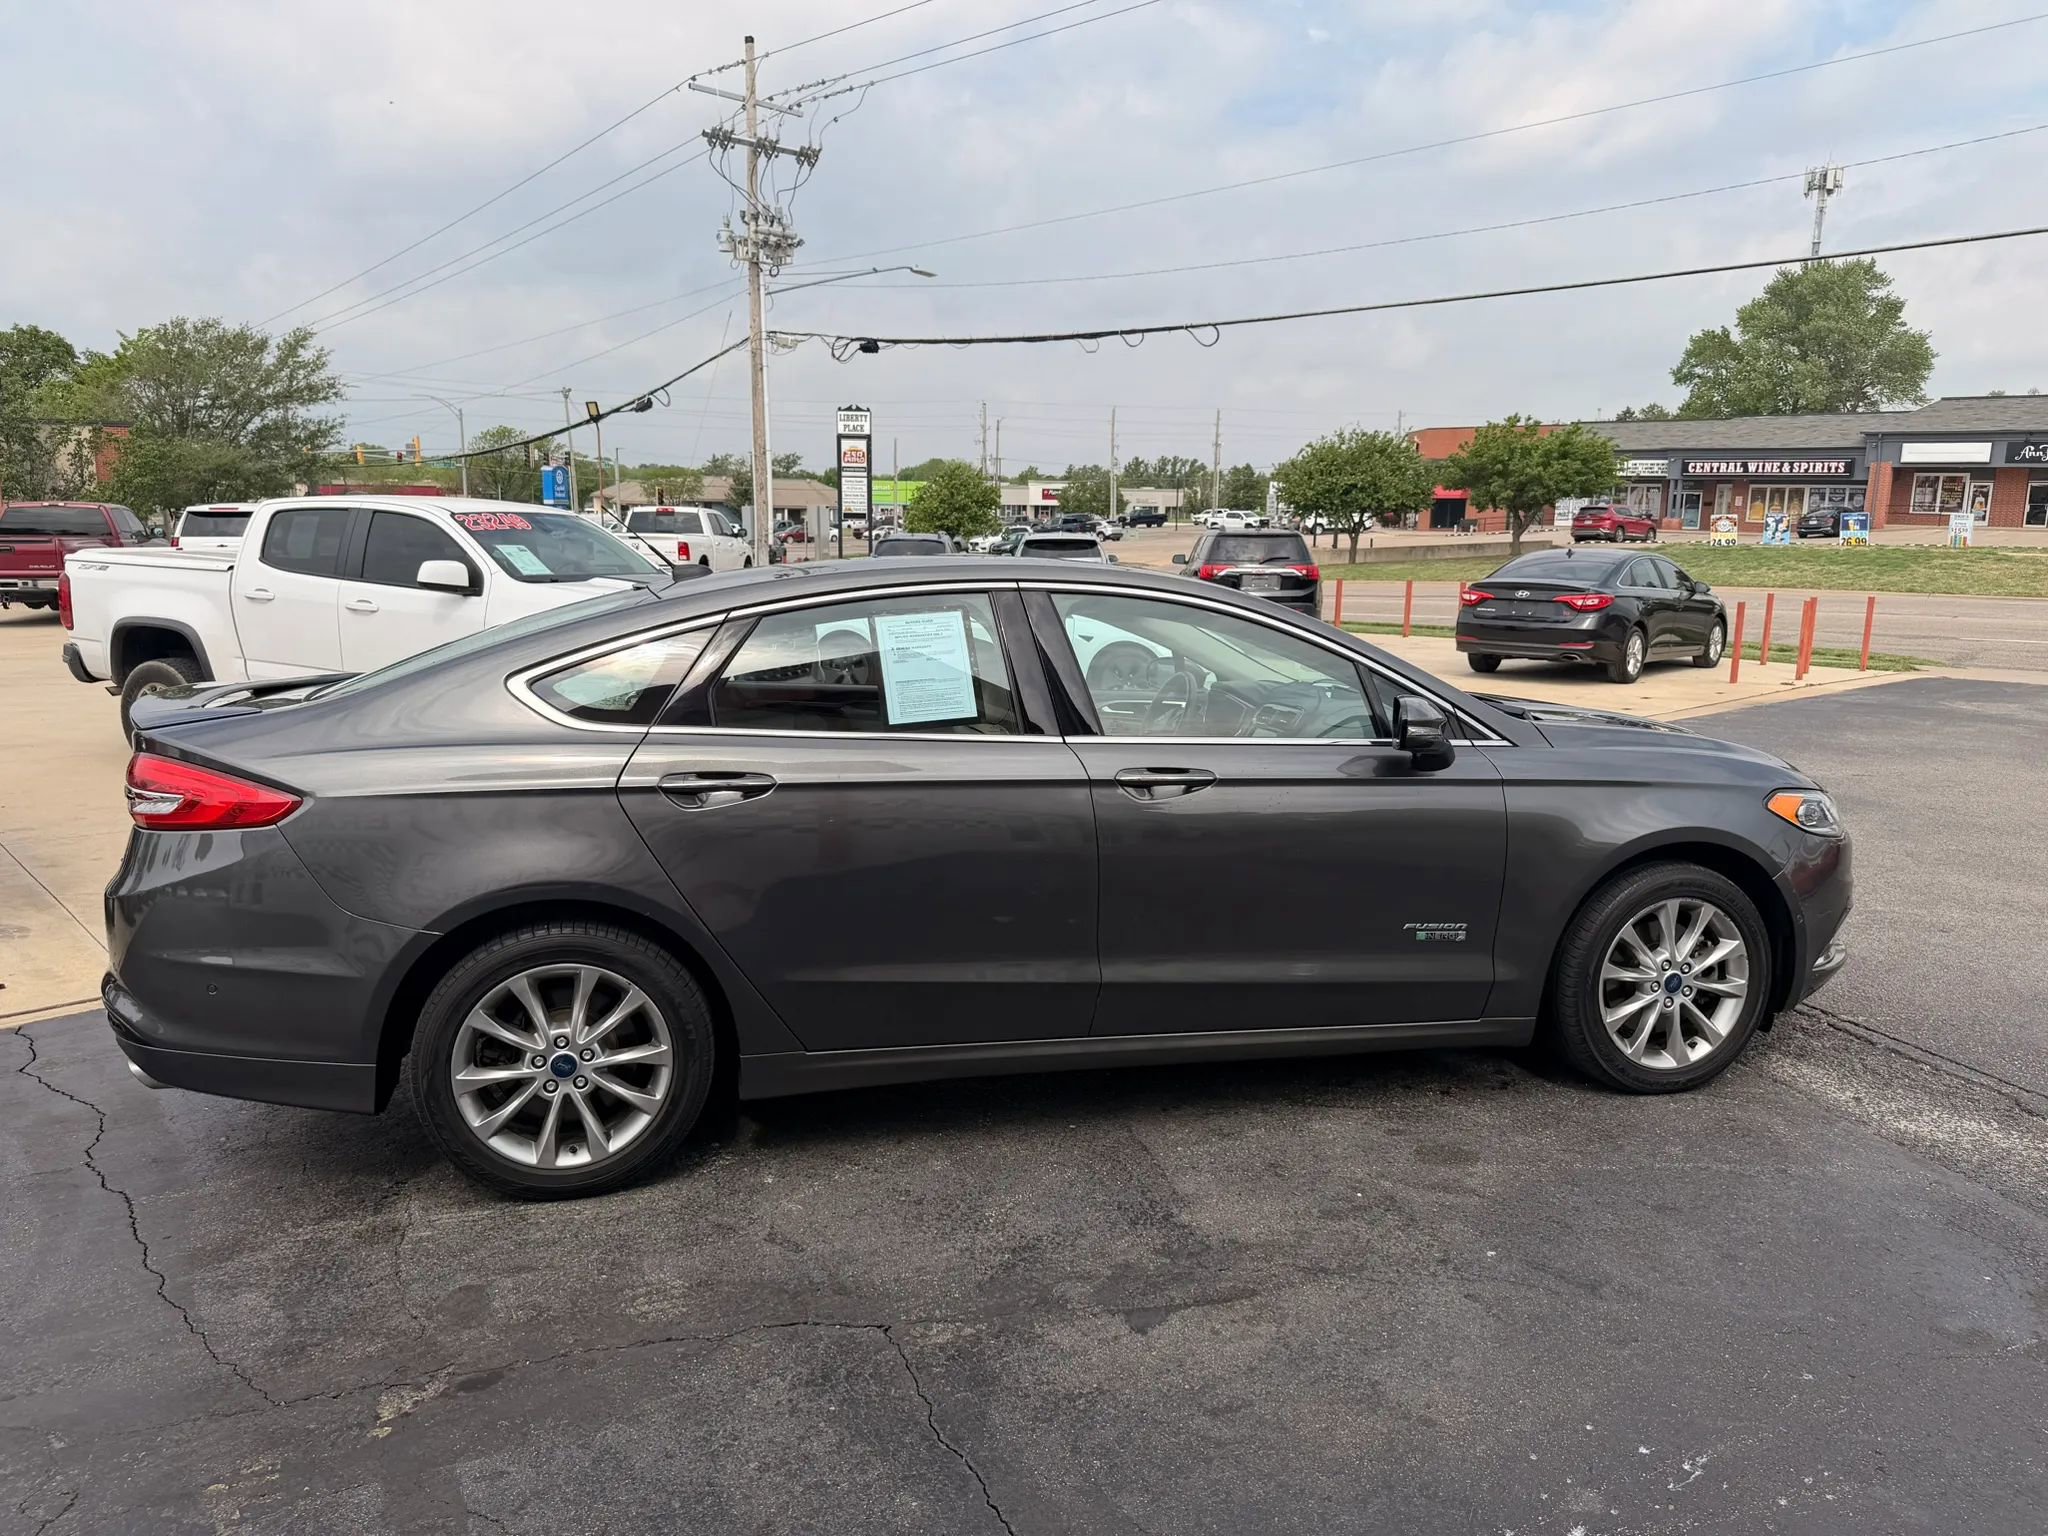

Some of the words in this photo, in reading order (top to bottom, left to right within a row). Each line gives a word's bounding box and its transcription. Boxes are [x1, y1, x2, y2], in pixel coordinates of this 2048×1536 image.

[839, 414, 868, 423] LIBERTY
[843, 424, 865, 433] PLACE
[1688, 462, 1744, 473] CENTRAL
[1747, 462, 1780, 473] WINE
[1792, 462, 1845, 473] SPIRITS
